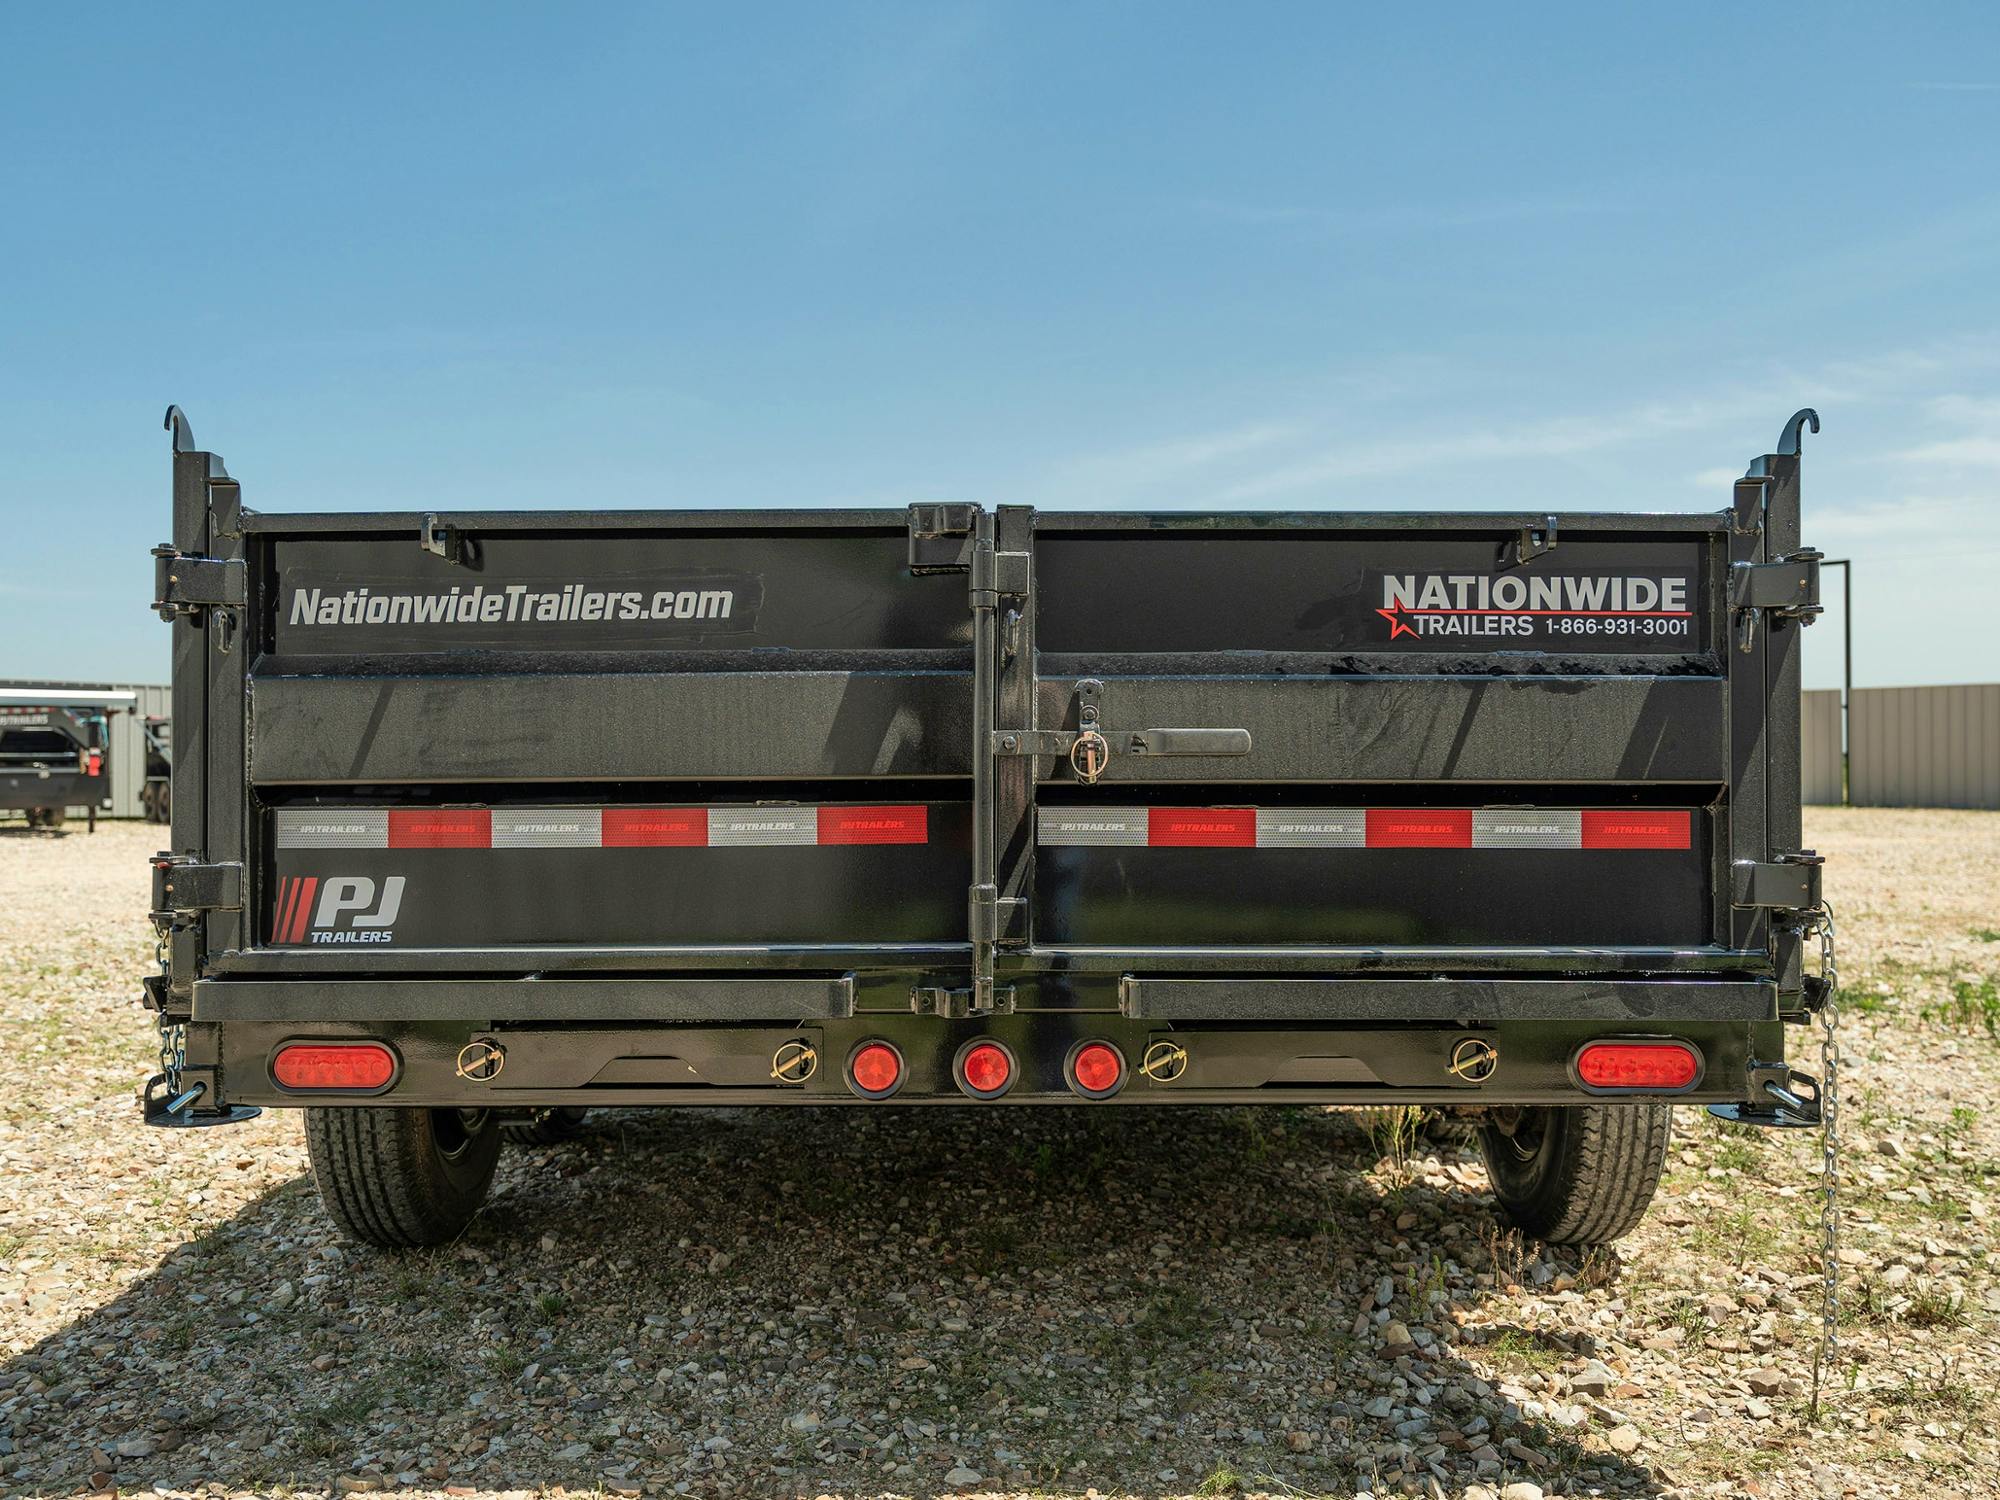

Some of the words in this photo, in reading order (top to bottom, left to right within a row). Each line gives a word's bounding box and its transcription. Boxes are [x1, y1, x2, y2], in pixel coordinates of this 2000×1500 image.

[289, 584, 734, 626] NationwideTrailers.com
[1383, 575, 1687, 612] NATIONWIDE
[1412, 614, 1534, 636] TRAILERS
[1546, 618, 1688, 636] 1-866-931-3001
[314, 876, 406, 928] PJ
[311, 931, 393, 943] TRAILERS
